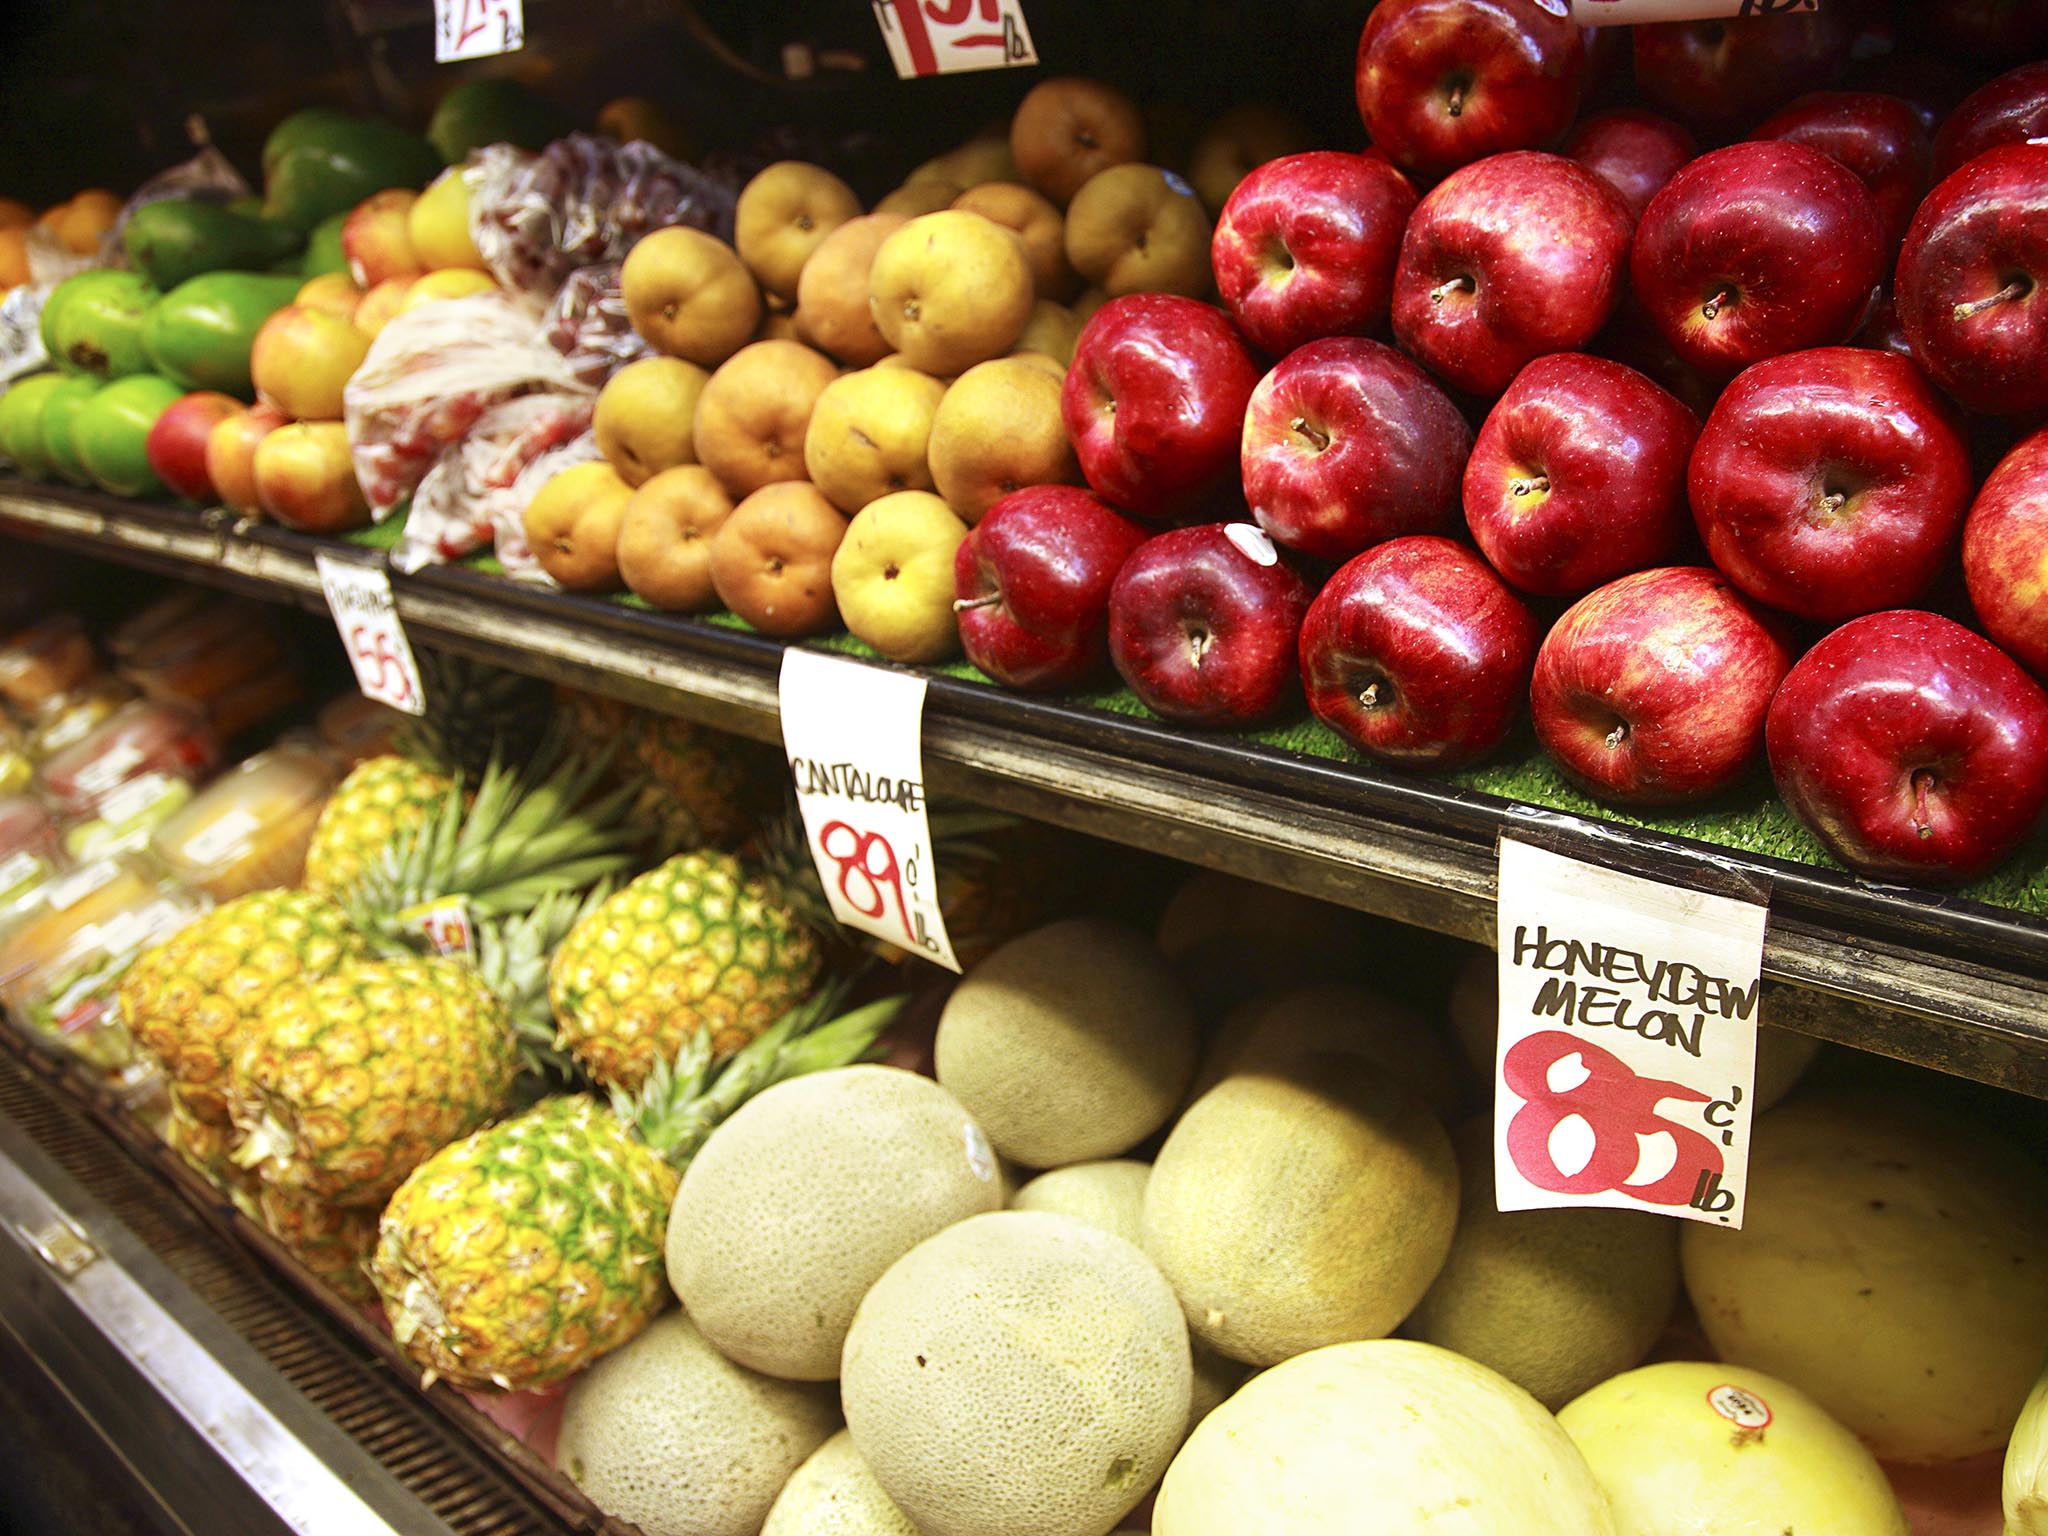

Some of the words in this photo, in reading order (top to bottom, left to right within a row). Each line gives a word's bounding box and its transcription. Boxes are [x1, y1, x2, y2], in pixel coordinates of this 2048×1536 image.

[792, 757, 925, 813] CANTALOUPE
[819, 820, 916, 943] 89
[1513, 926, 1759, 1020] HONEYDEW
[1532, 977, 1705, 1057] MELON
[1503, 1030, 1724, 1205] 85
